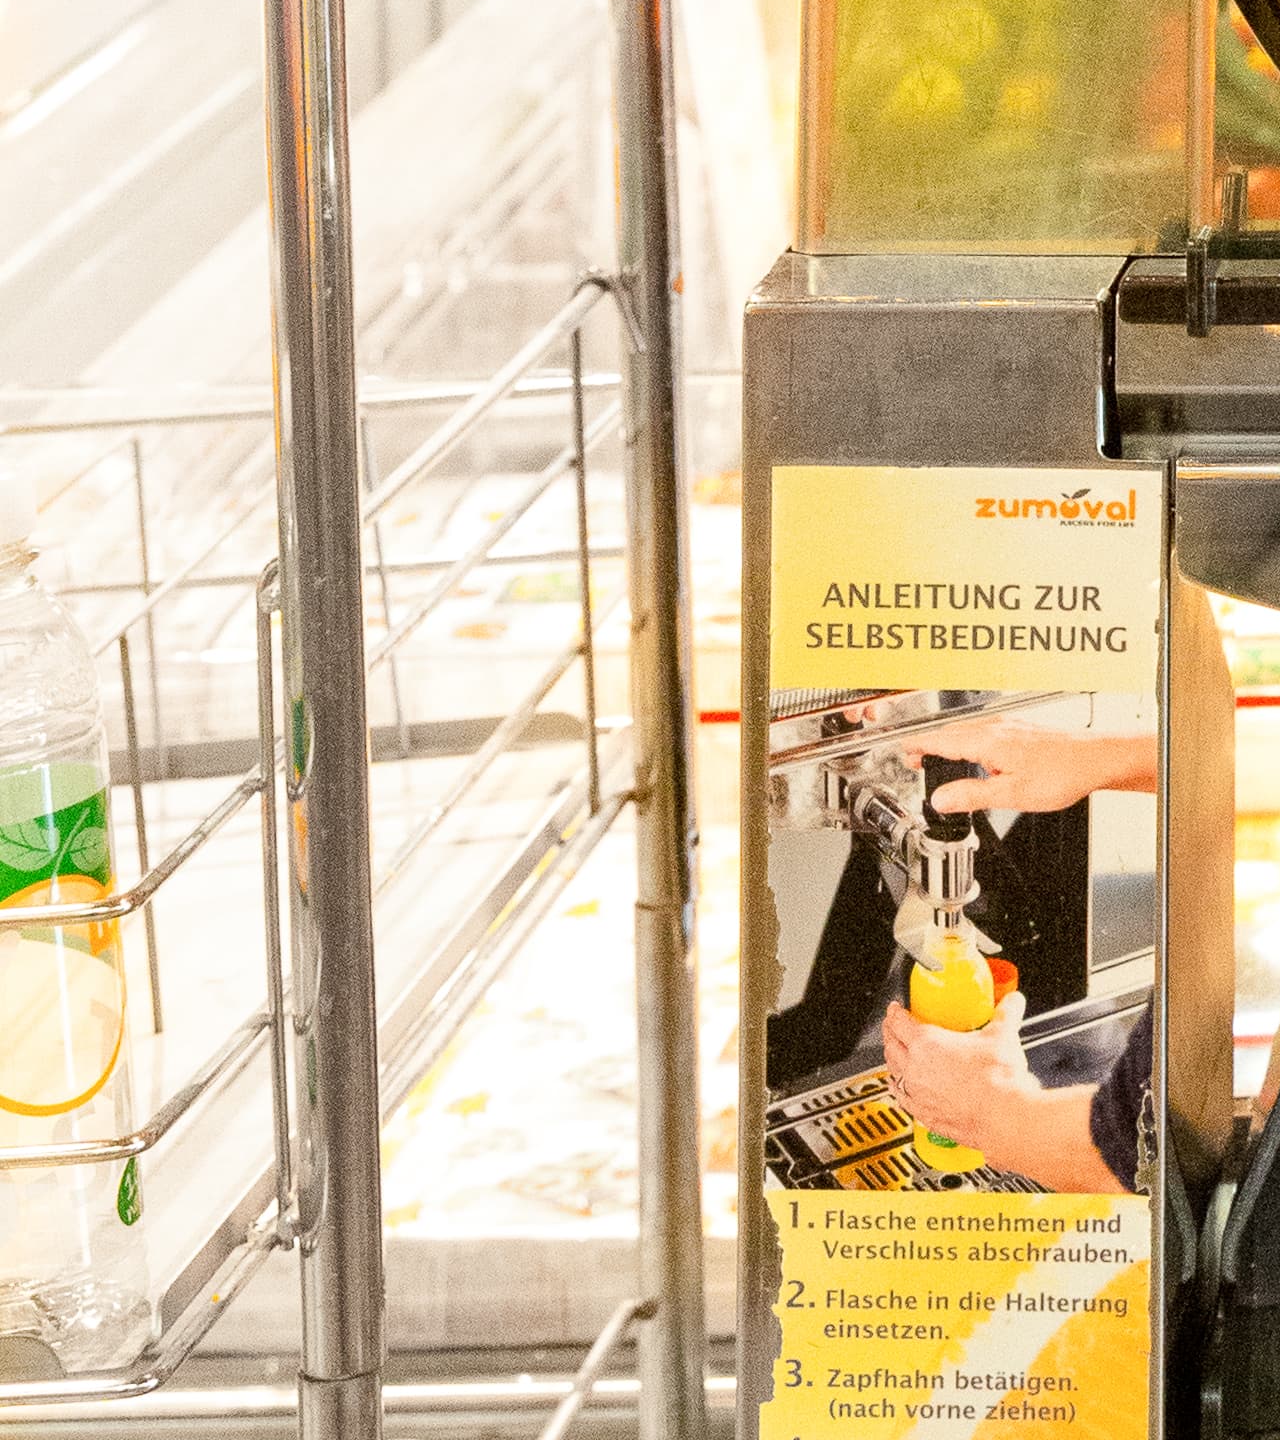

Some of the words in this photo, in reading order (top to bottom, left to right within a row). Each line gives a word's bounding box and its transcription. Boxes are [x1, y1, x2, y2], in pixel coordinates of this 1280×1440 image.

[975, 488, 1137, 521] zumoval
[822, 582, 1021, 610] ANLEITUNG
[1035, 585, 1101, 612] ZUR
[806, 622, 1127, 653] SELBSTBEDIENUNG
[789, 1201, 815, 1229] 1.
[825, 1210, 916, 1231] Flasche
[926, 1213, 1066, 1234] entnehmen
[1076, 1214, 1121, 1234] und
[823, 1240, 958, 1262] Verschluss
[969, 1242, 1134, 1264] abschrauben.
[786, 1280, 816, 1308] 2.
[826, 1290, 917, 1310] Flasche
[928, 1291, 949, 1311] in
[959, 1292, 995, 1312] die
[1005, 1293, 1128, 1317] Halterung
[824, 1321, 950, 1341] einsetzen.
[785, 1359, 813, 1387] 3.
[827, 1369, 944, 1393] Zapfhahn
[955, 1370, 1078, 1395] betätigen.
[829, 1398, 895, 1420] (nach
[905, 1404, 975, 1420] vorne
[985, 1400, 1076, 1423] ziehen)
